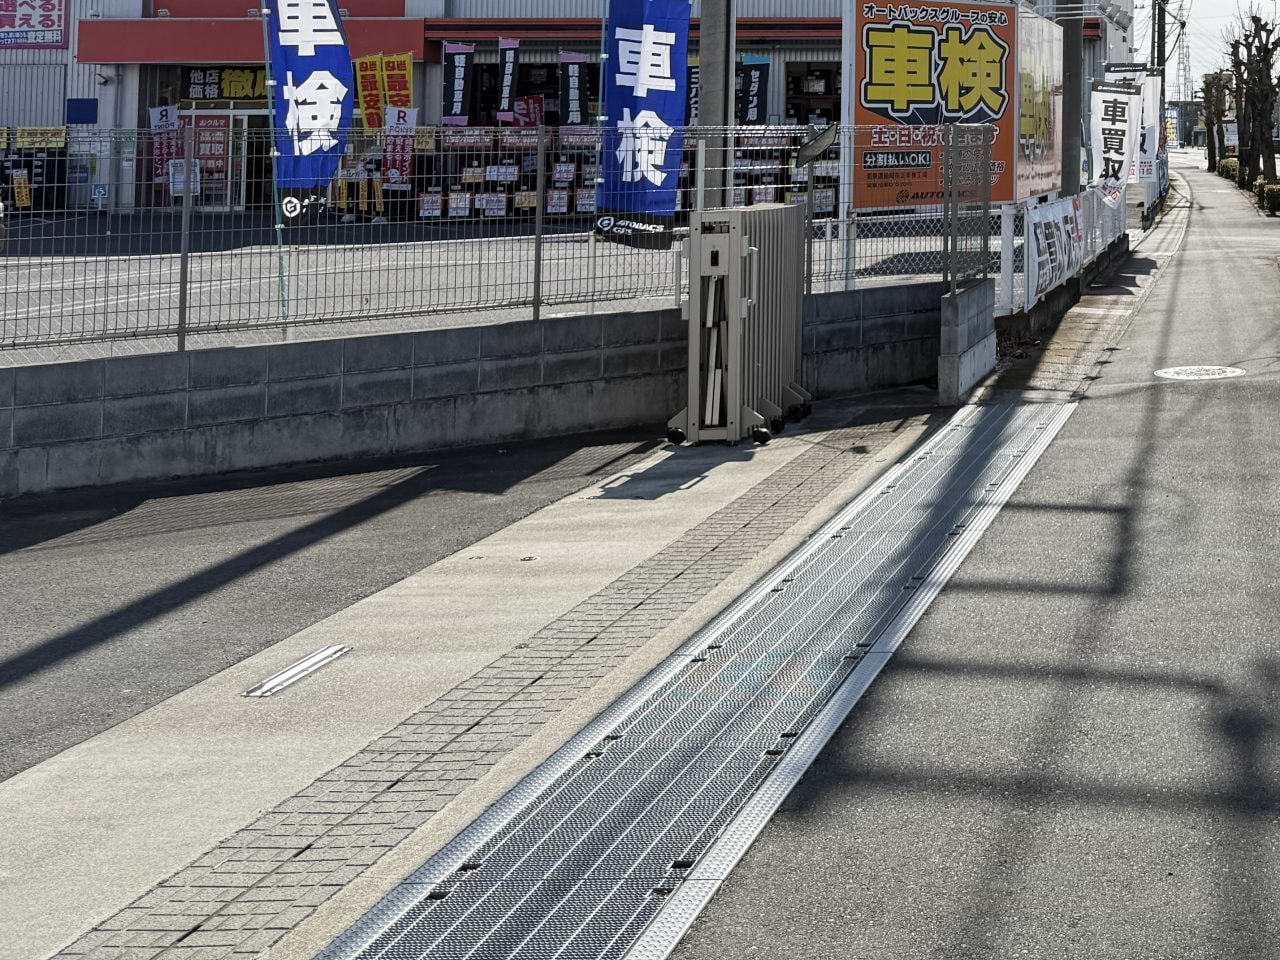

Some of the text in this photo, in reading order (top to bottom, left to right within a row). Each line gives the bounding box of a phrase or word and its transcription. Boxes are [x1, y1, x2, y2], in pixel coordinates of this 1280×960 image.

[863, 3, 1008, 26] オートバックスグループの安心
[189, 69, 219, 84] 他店
[451, 54, 466, 115] 軽自動車用
[864, 23, 1008, 115] 車検
[189, 84, 219, 98] 価格
[567, 64, 582, 124] 軽自動車用
[614, 24, 677, 187] 車検
[747, 69, 761, 122] セダン用
[396, 110, 408, 123] R
[200, 143, 224, 155] 買取
[1099, 98, 1128, 182] 車買取
[864, 153, 930, 166] 分割払いOK!
